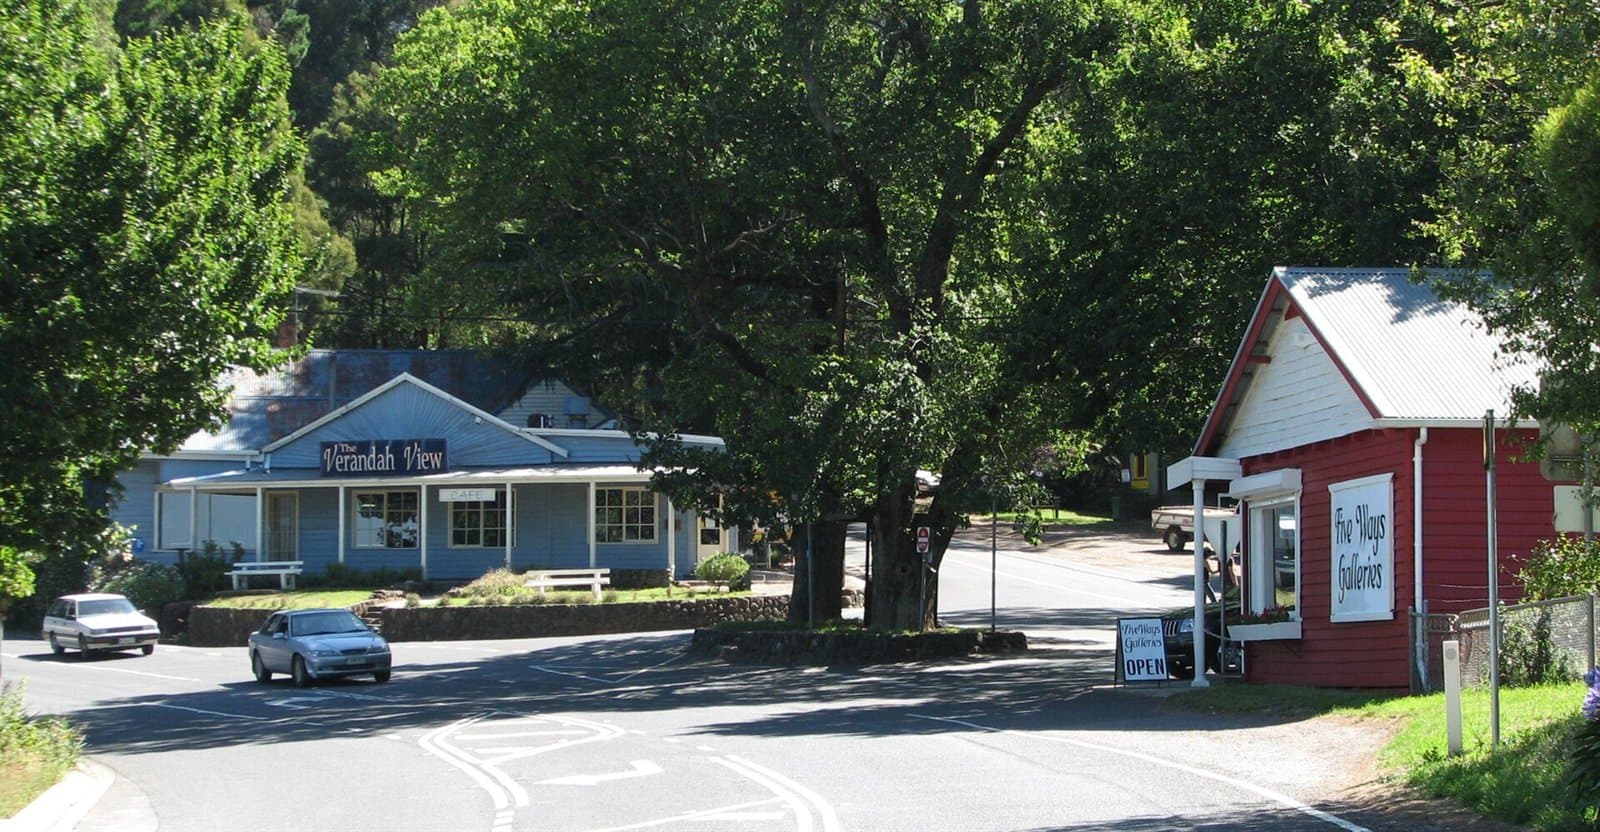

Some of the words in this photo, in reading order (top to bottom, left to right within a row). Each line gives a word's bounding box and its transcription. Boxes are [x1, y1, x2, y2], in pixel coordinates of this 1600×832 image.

[324, 444, 395, 472] Verandah
[404, 442, 442, 470] View
[341, 443, 357, 453] The
[1335, 507, 1352, 544] Five
[1355, 504, 1386, 556] Ways
[1338, 553, 1382, 604] Galleries
[1126, 659, 1165, 676] OPEN
